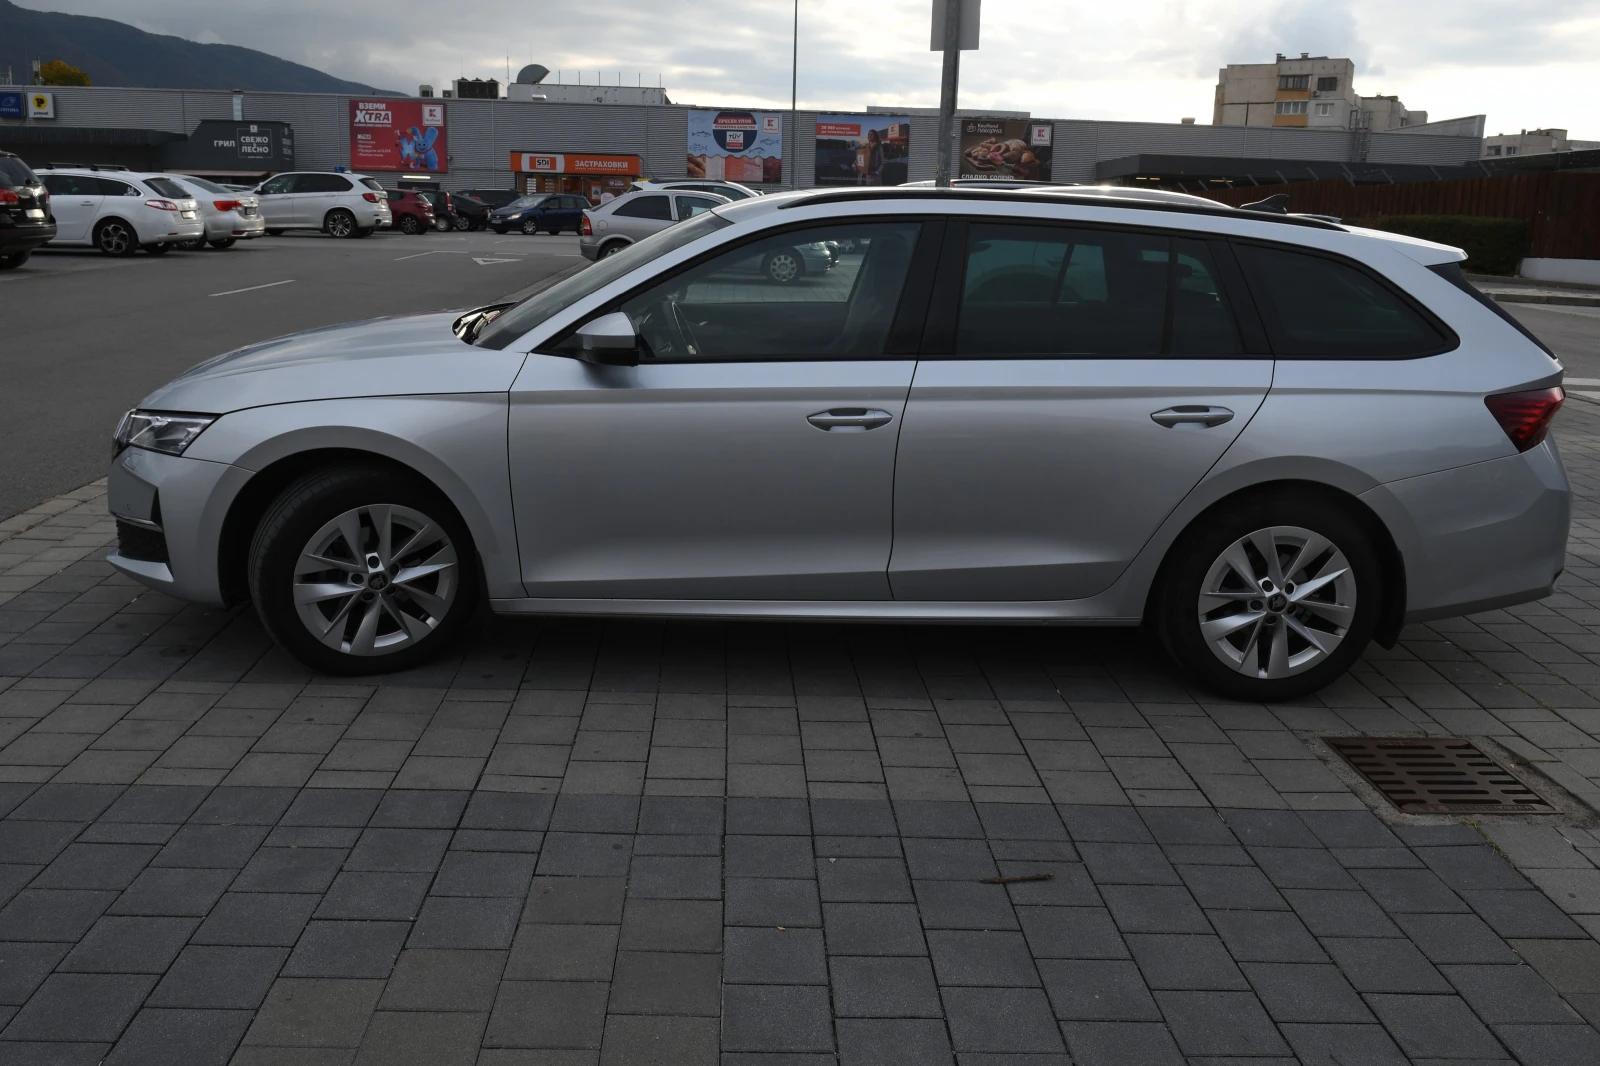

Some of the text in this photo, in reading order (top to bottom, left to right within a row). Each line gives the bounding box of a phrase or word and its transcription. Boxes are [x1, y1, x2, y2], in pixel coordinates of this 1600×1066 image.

[358, 102, 386, 110] ВЗЕМИ
[354, 110, 391, 123] XTRA
[240, 135, 269, 143] СВЕЖО
[574, 160, 628, 168] ЗАСТРАХОВКИ
